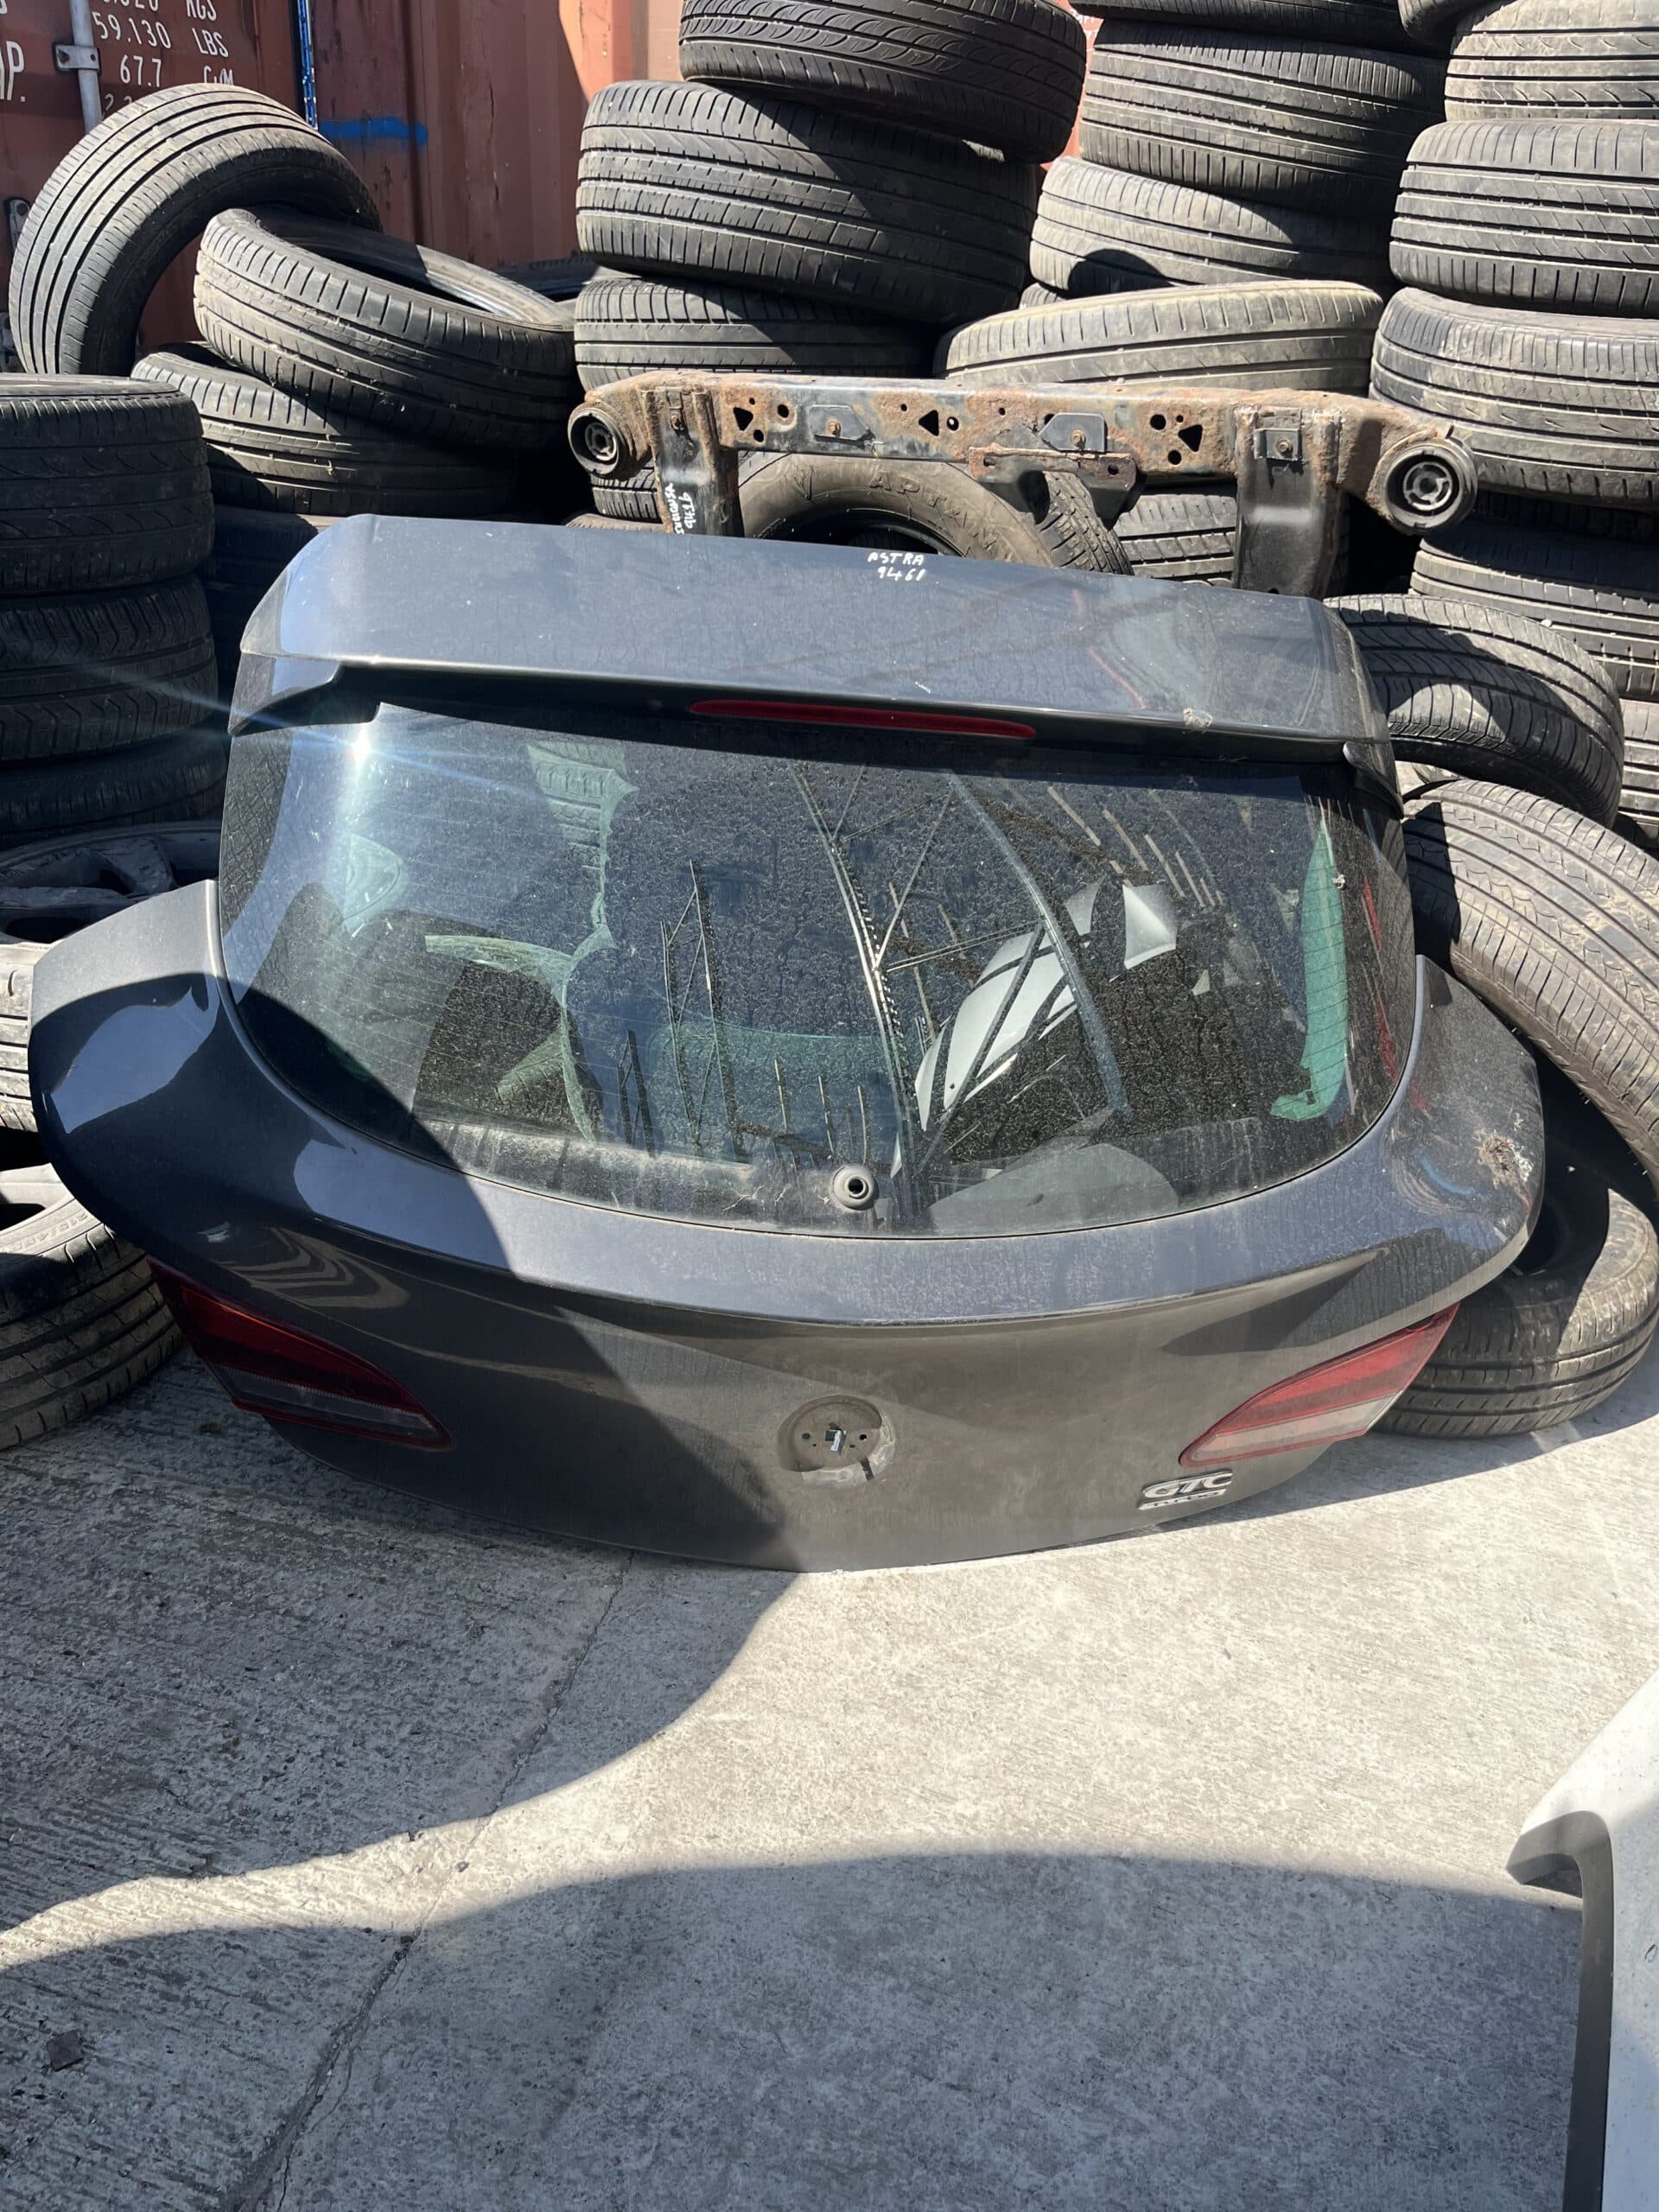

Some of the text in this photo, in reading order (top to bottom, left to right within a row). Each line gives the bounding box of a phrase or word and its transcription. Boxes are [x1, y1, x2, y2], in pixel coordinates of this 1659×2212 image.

[92, 11, 229, 58] 59.130 LBS
[120, 54, 162, 87] 67.7
[867, 551, 925, 566] ASTRA
[877, 566, 926, 582] 9461
[1141, 1470, 1233, 1498] GTC
